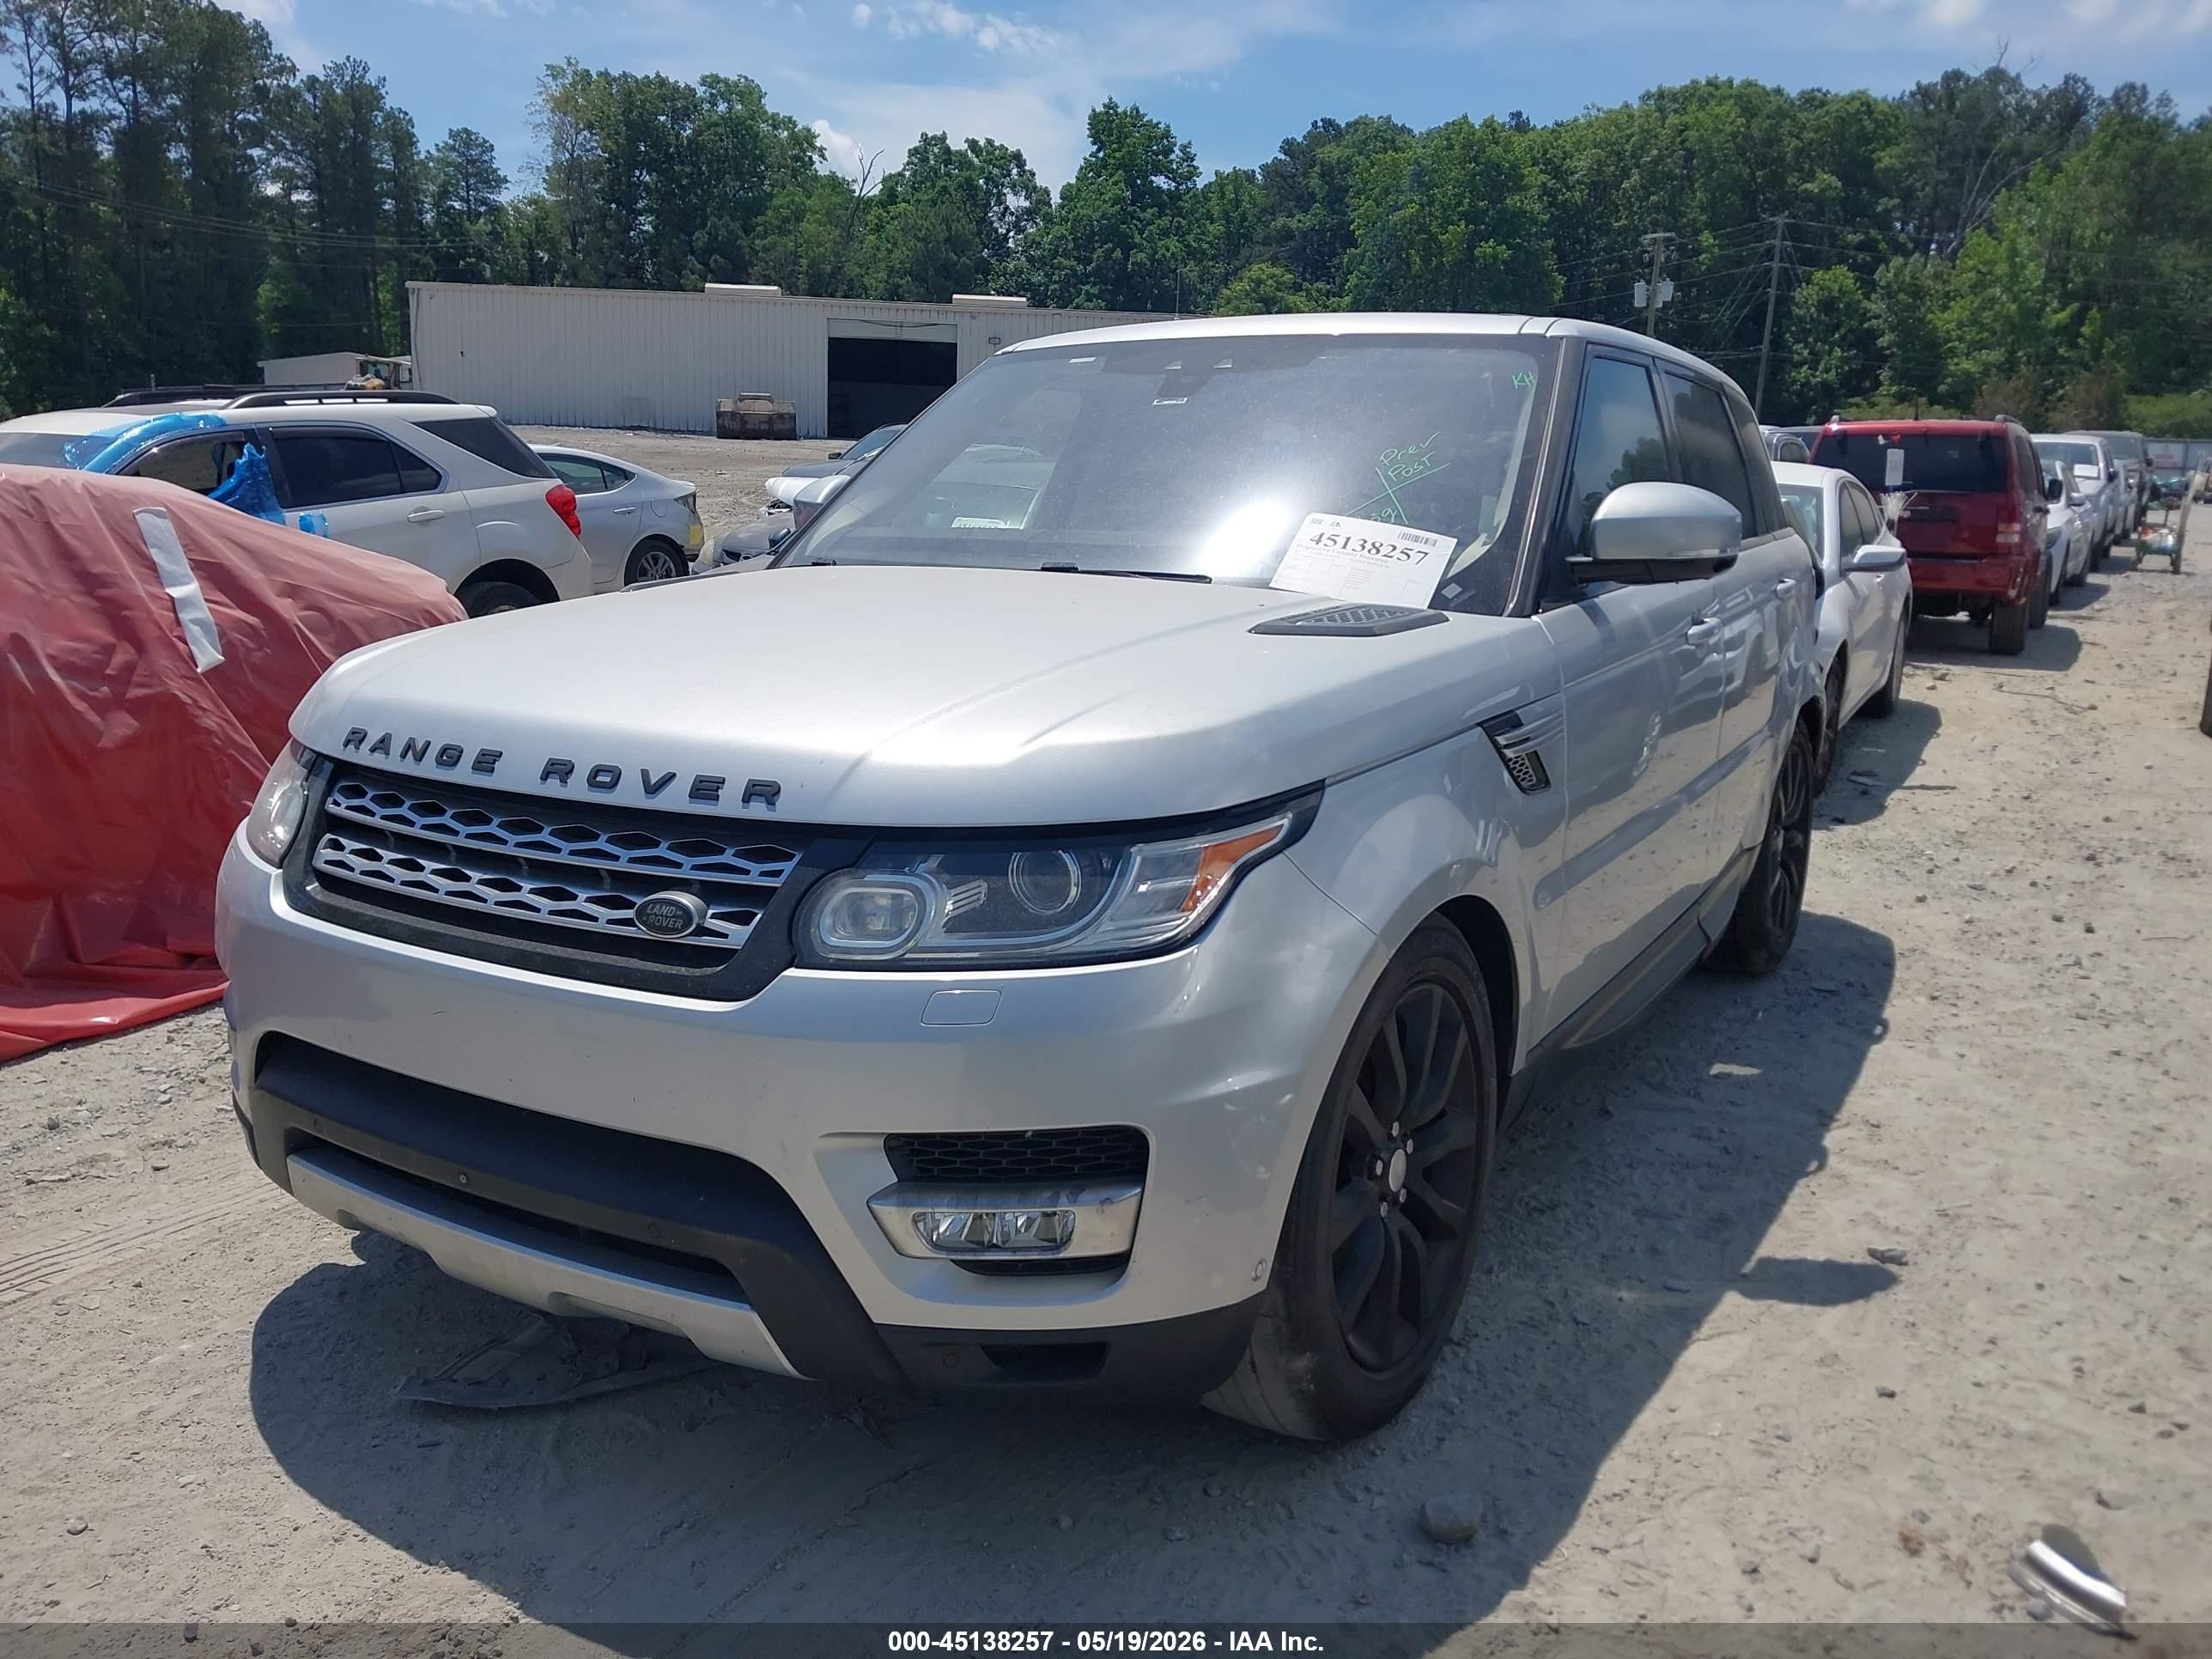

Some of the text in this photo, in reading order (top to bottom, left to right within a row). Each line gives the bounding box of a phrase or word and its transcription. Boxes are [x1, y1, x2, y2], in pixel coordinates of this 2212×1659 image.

[1309, 532, 1430, 565] 45138257
[343, 726, 782, 810] RANGE ROVER
[646, 903, 677, 917] LAND
[648, 914, 684, 928] ROVER
